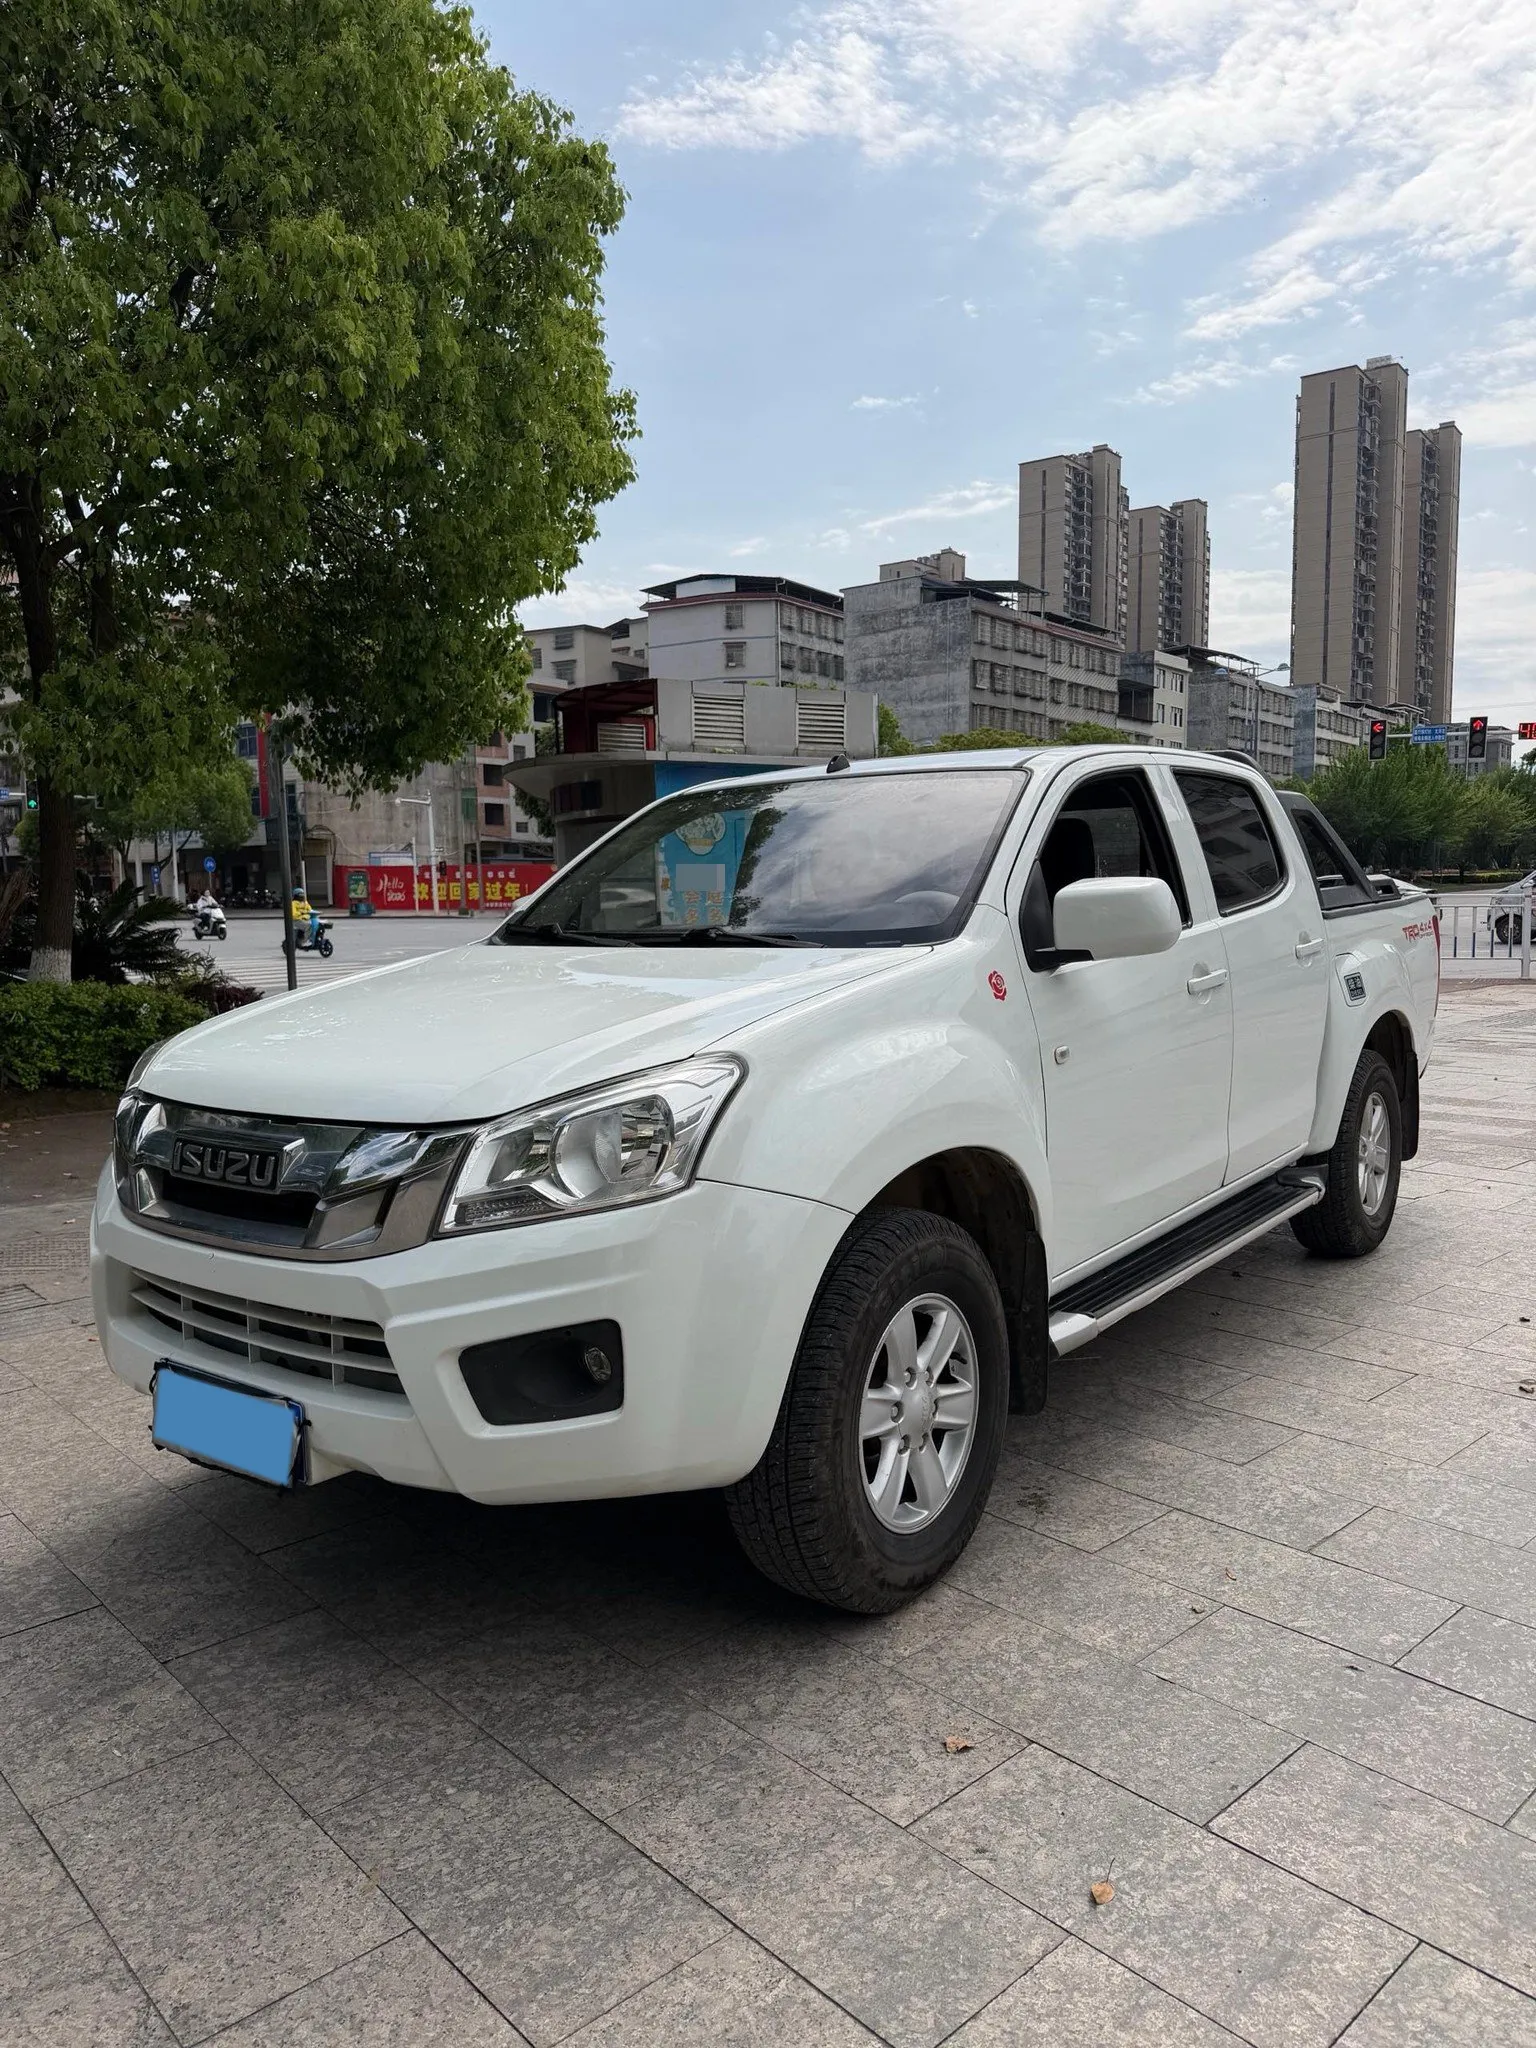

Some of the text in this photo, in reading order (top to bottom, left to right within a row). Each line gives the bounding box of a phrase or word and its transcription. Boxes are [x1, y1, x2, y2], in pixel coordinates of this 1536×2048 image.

[376, 874, 404, 901] Hello
[1402, 924, 1420, 942] TRD
[174, 1141, 276, 1187] ISUZU
